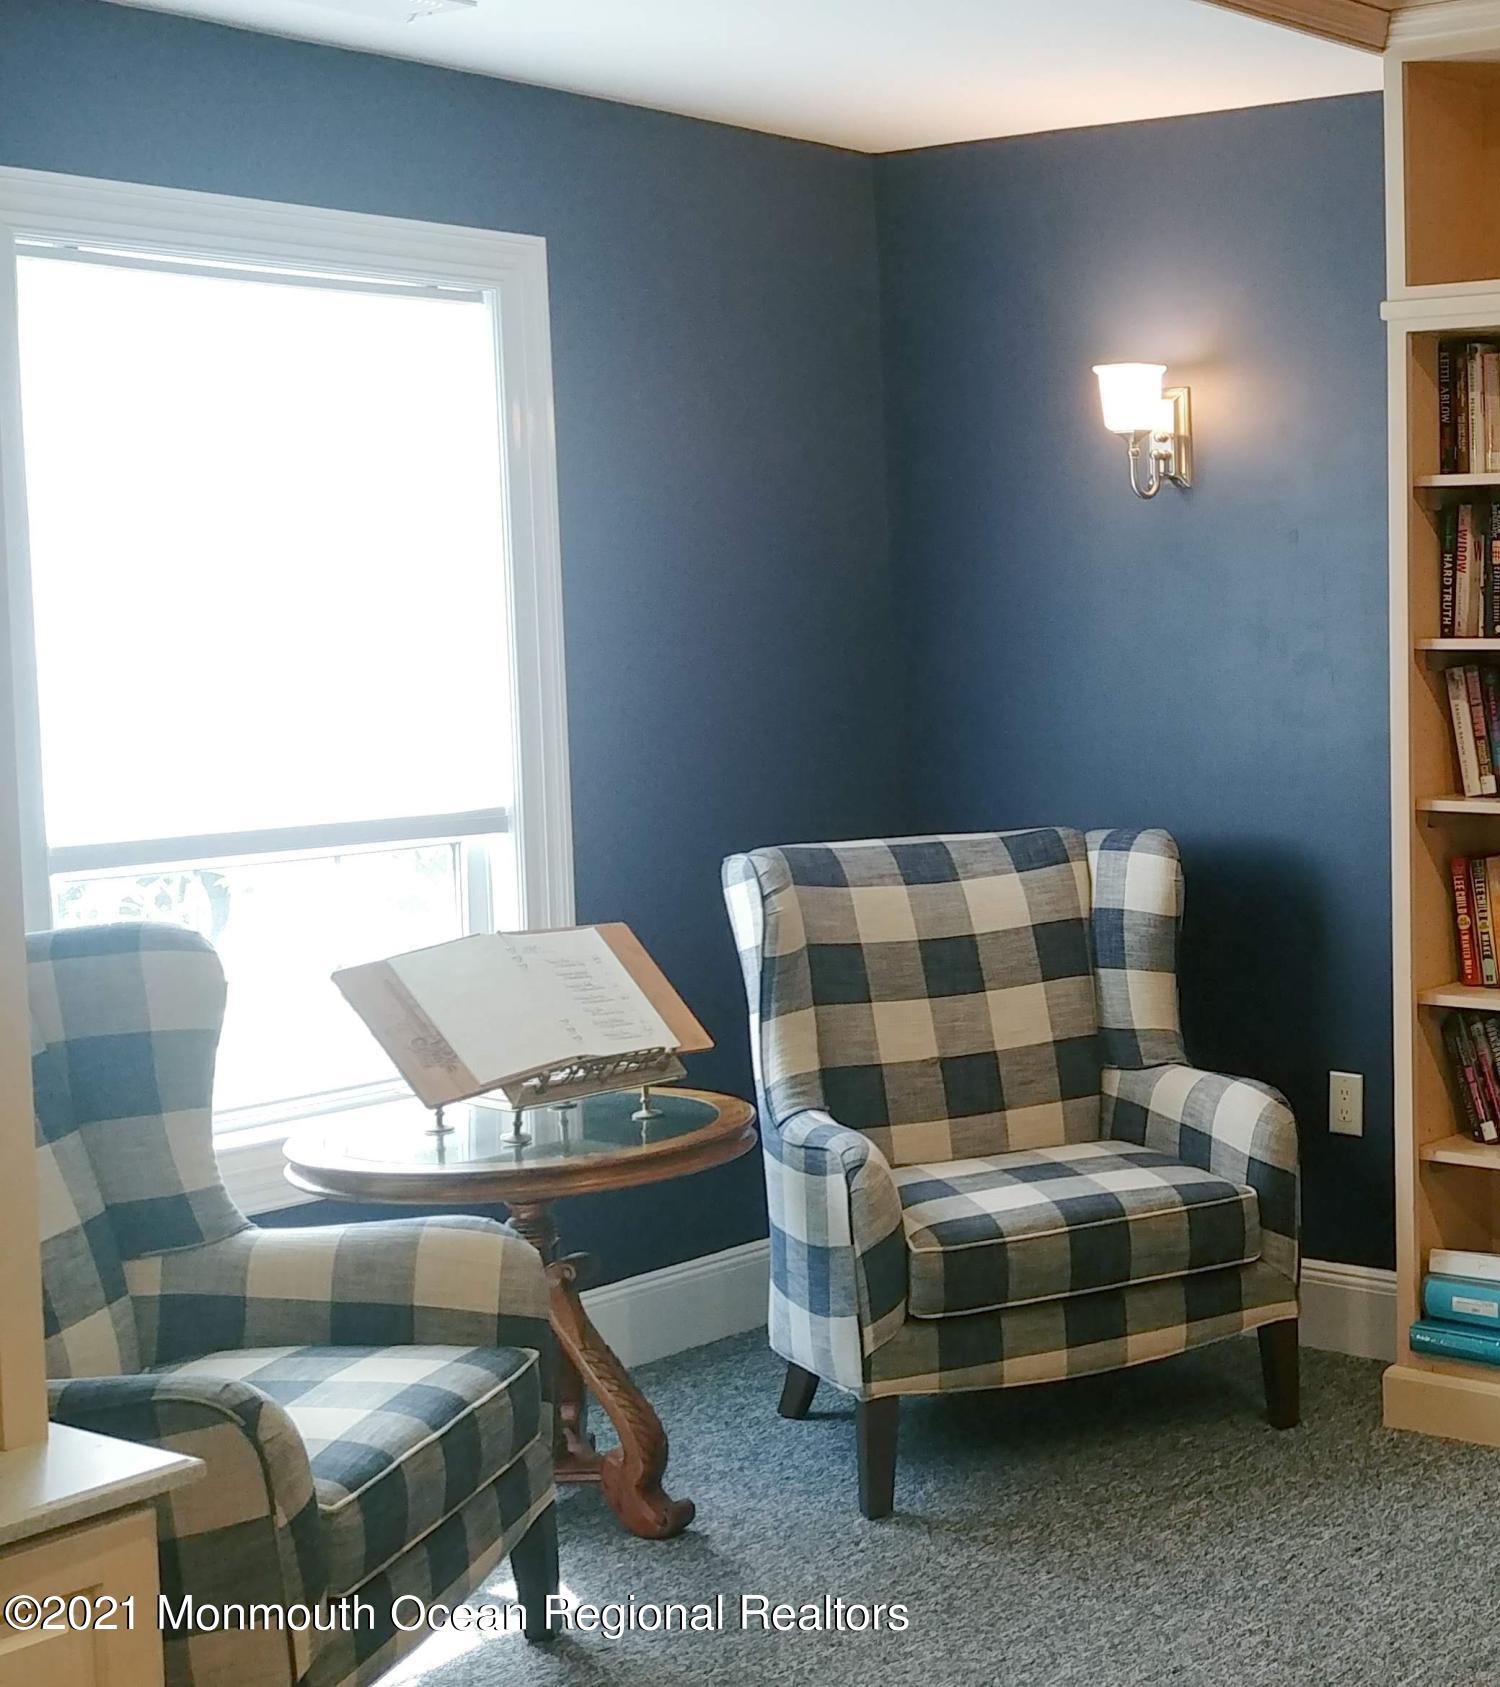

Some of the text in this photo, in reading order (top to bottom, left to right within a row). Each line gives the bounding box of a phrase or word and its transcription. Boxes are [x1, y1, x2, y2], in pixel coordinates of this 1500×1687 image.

[1440, 352, 1451, 423] KEITH ABLOW
[1457, 529, 1468, 574] WIDOW
[1443, 554, 1452, 624] HARD TRUTH
[1453, 876, 1468, 914] LEE CHILD
[1474, 878, 1487, 917] LEE CHILD
